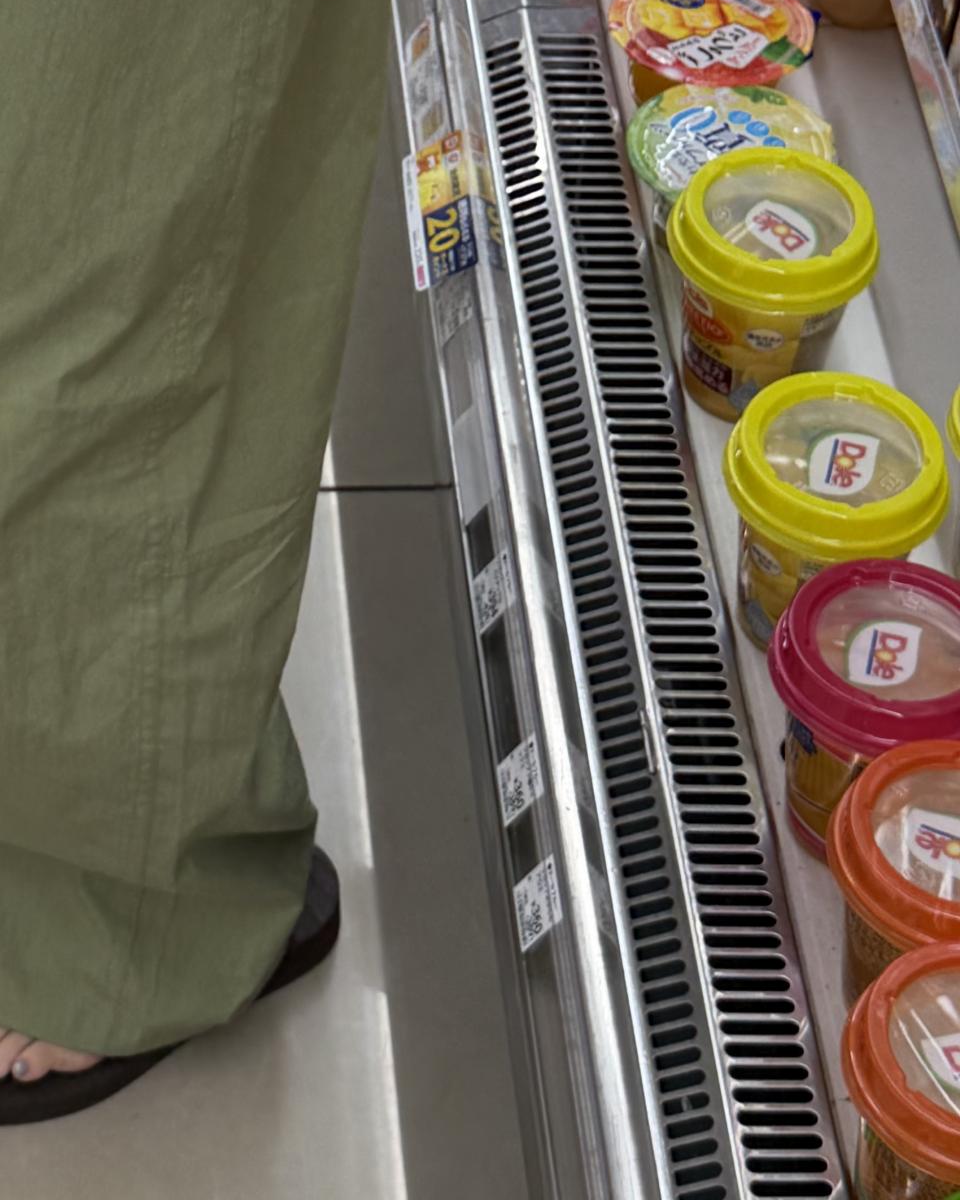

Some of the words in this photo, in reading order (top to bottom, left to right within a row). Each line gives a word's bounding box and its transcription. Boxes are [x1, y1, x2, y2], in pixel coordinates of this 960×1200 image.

[427, 208, 460, 253] 20
[752, 213, 805, 252] Dole
[832, 441, 866, 488] Dole
[873, 632, 908, 679] Dole
